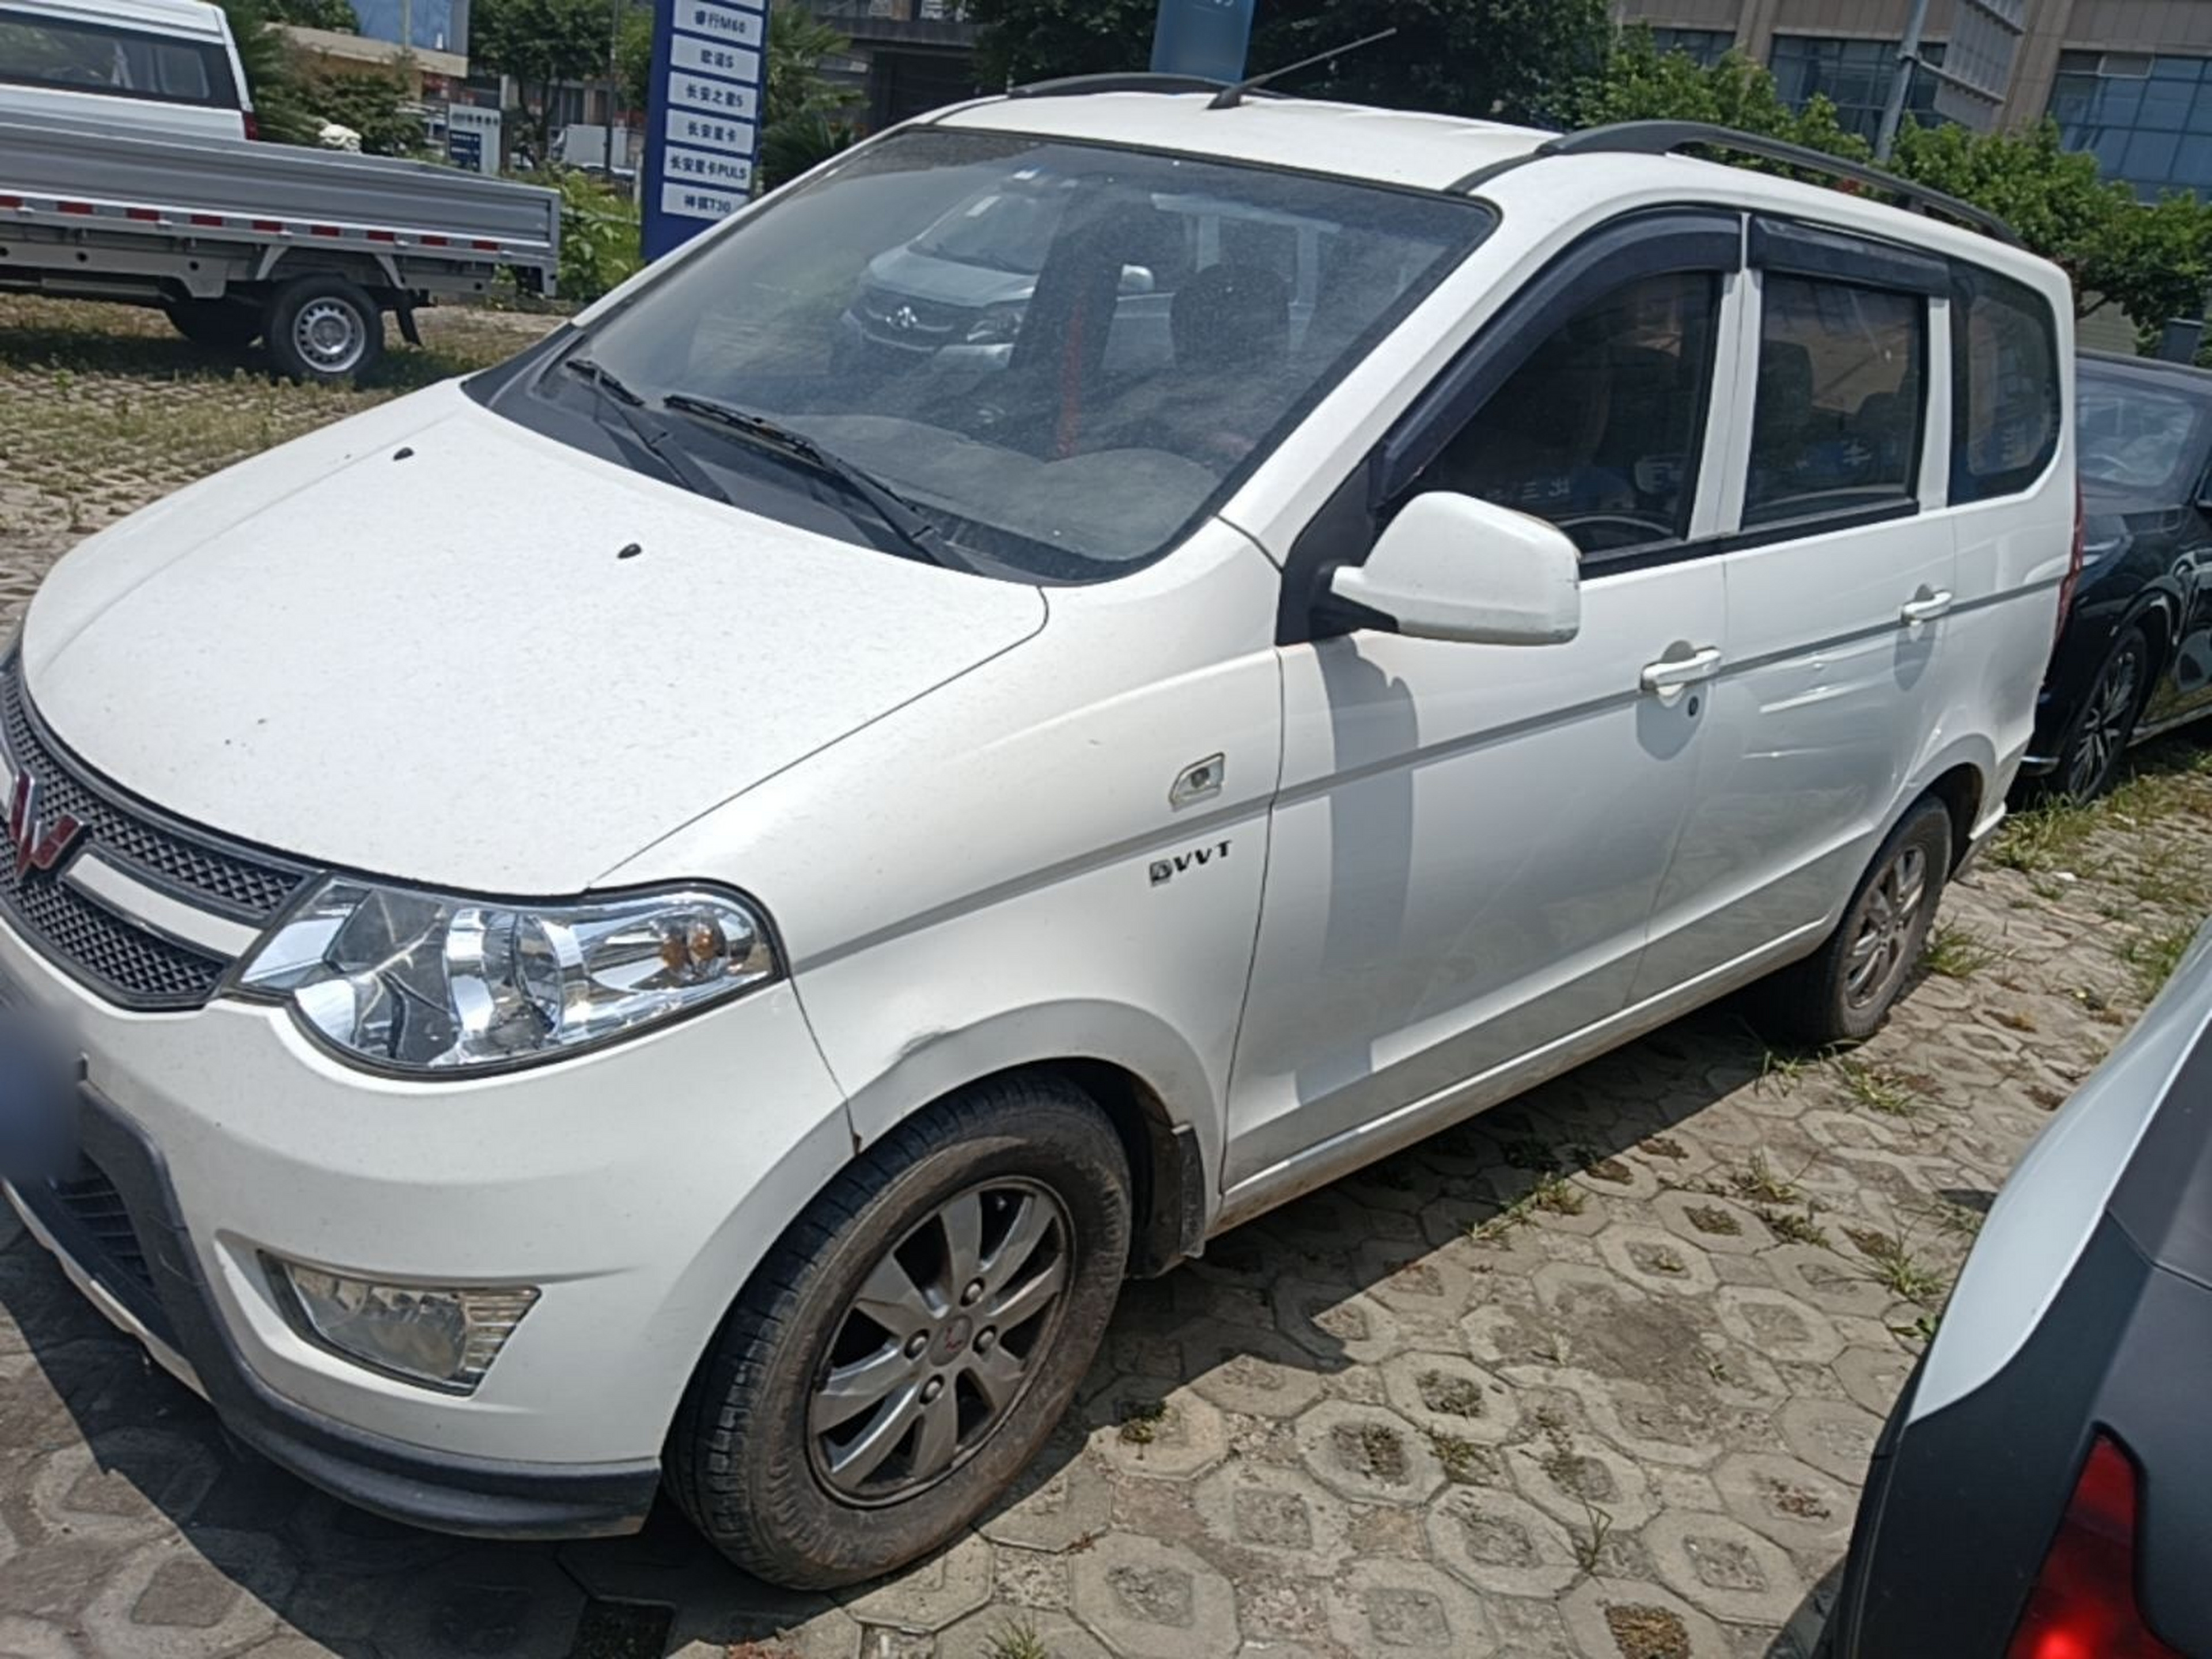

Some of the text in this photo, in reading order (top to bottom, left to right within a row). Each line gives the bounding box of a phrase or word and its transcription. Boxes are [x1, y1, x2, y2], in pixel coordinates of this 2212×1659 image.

[687, 82, 743, 108] 长安之星5
[687, 120, 737, 142] 长安星卡
